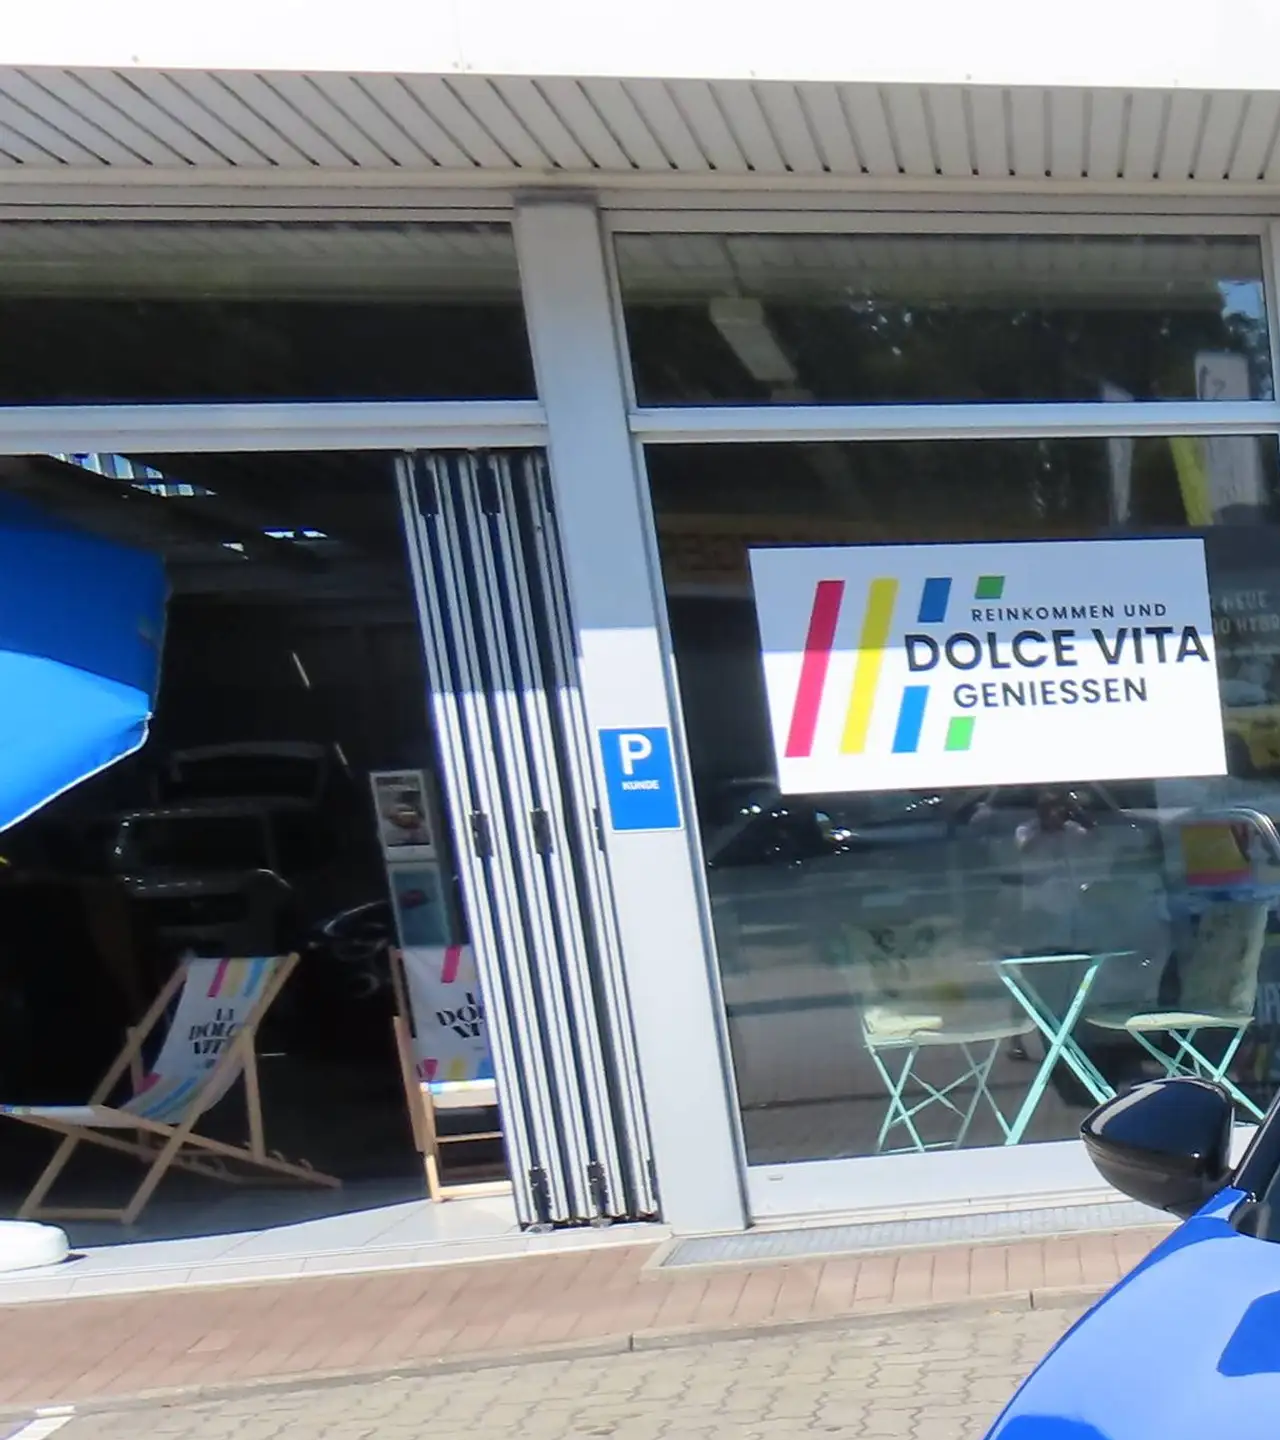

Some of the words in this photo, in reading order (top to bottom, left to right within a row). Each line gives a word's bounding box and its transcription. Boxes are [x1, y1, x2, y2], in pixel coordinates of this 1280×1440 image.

[971, 603, 1116, 623] REINKOMMEN
[1123, 602, 1168, 619] UND
[903, 629, 1078, 673] DOLCE
[1092, 625, 1210, 667] VITA
[952, 677, 1148, 709] GENIESSEN
[619, 734, 652, 775] P
